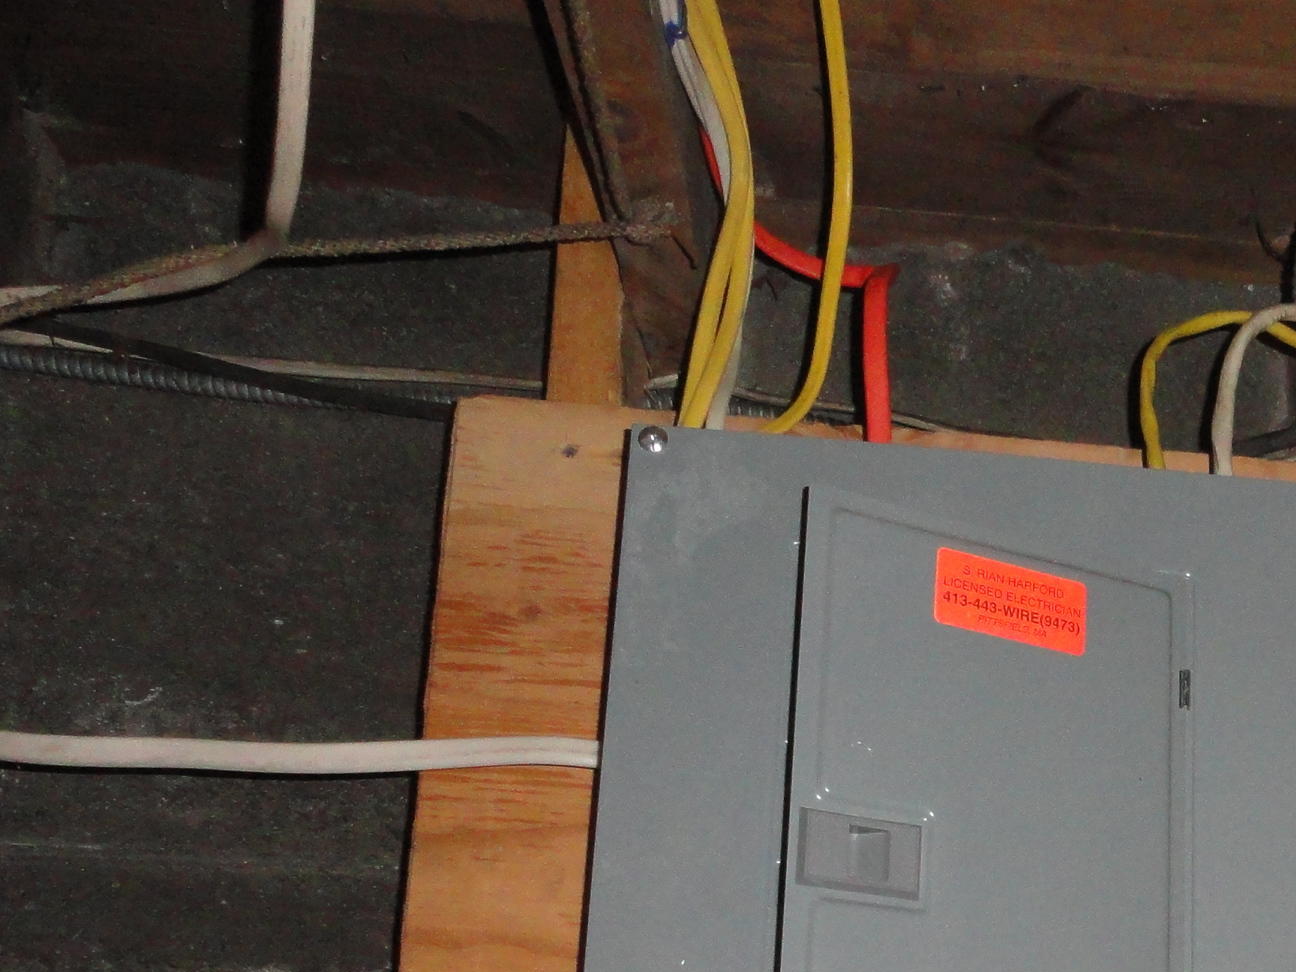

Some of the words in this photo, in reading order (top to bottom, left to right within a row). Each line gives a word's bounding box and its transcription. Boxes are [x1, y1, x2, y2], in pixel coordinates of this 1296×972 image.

[943, 575, 1003, 600] LICENSED
[1006, 591, 1082, 618] ELECTRICIAN
[943, 590, 1081, 636] 413-443-WIRE(9473)
